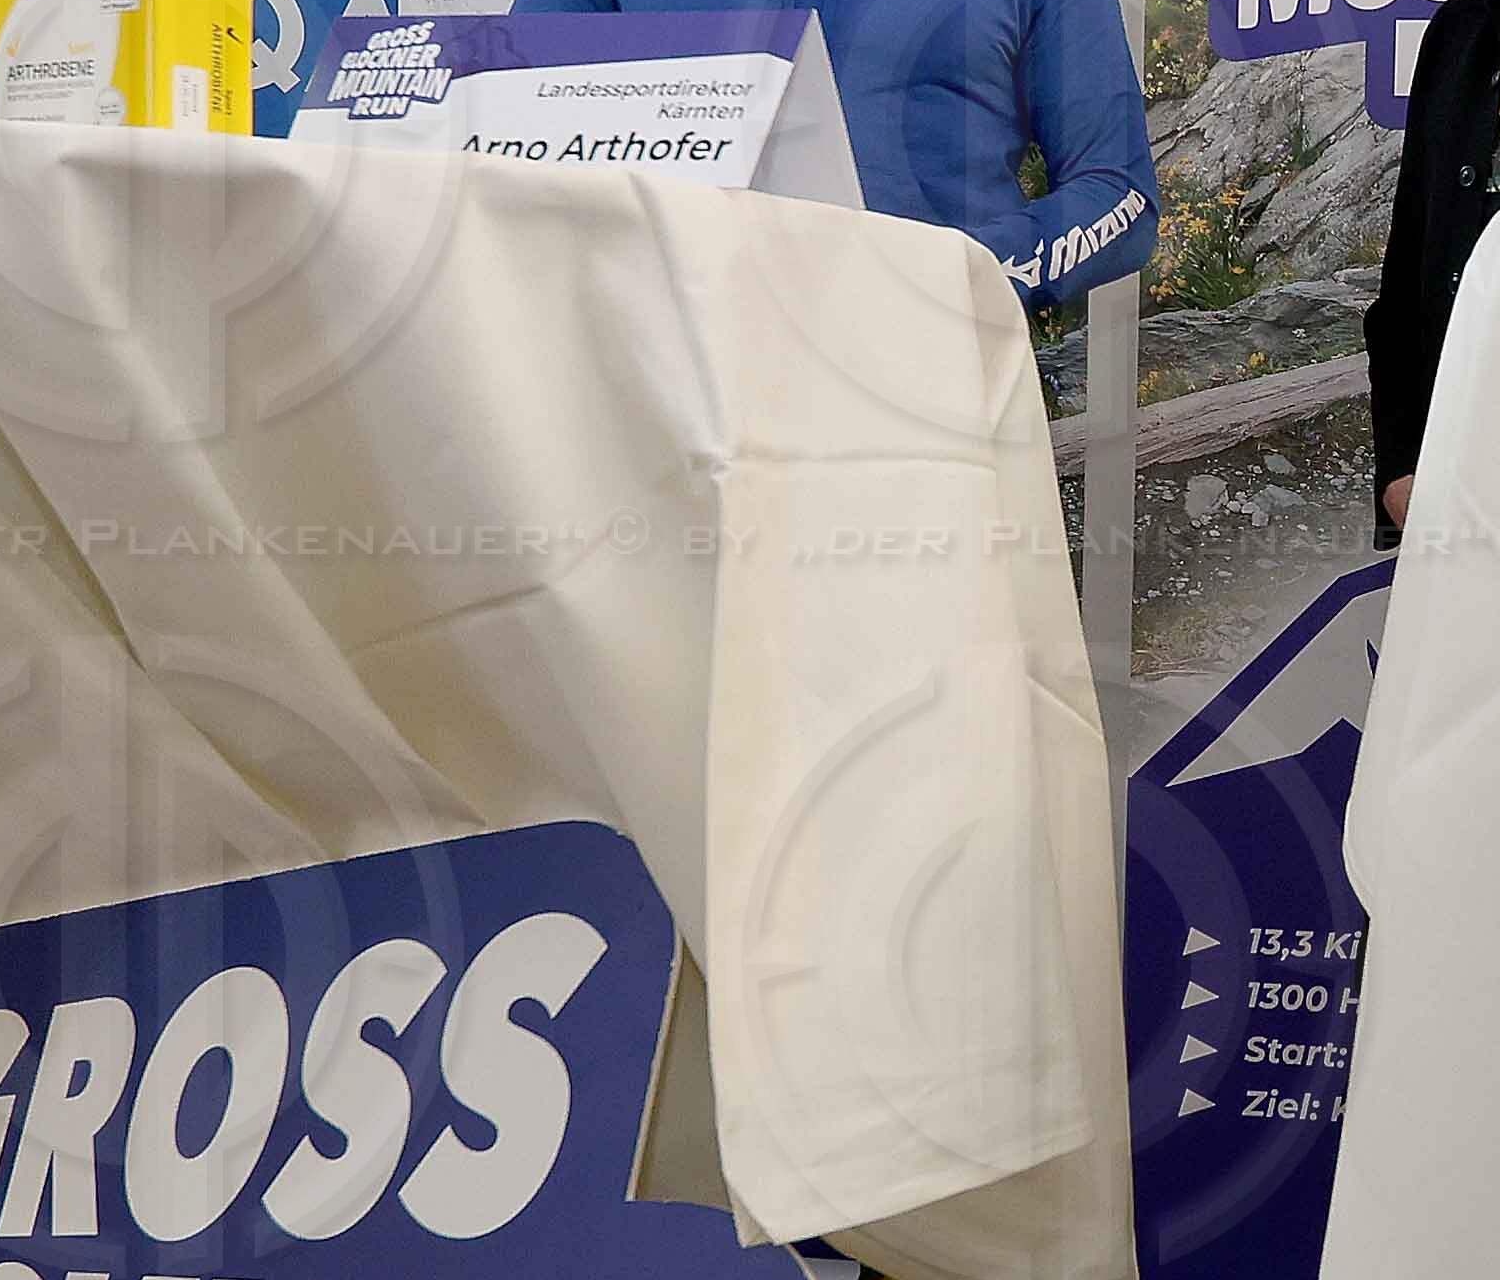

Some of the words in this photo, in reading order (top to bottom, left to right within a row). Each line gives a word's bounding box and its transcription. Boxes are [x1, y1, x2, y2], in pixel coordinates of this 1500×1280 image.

[368, 21, 436, 50] GROSS
[327, 68, 452, 102] MOUNTAIN
[537, 79, 755, 101] Landessportdirektor
[352, 97, 410, 115] RUN
[657, 103, 745, 120] Kärnten
[557, 132, 732, 162] Arthofer
[1248, 927, 1313, 960] 13,3
[1246, 982, 1330, 1013] 1300
[1243, 1036, 1348, 1069] Start:
[1241, 1090, 1320, 1122] Ziel:
